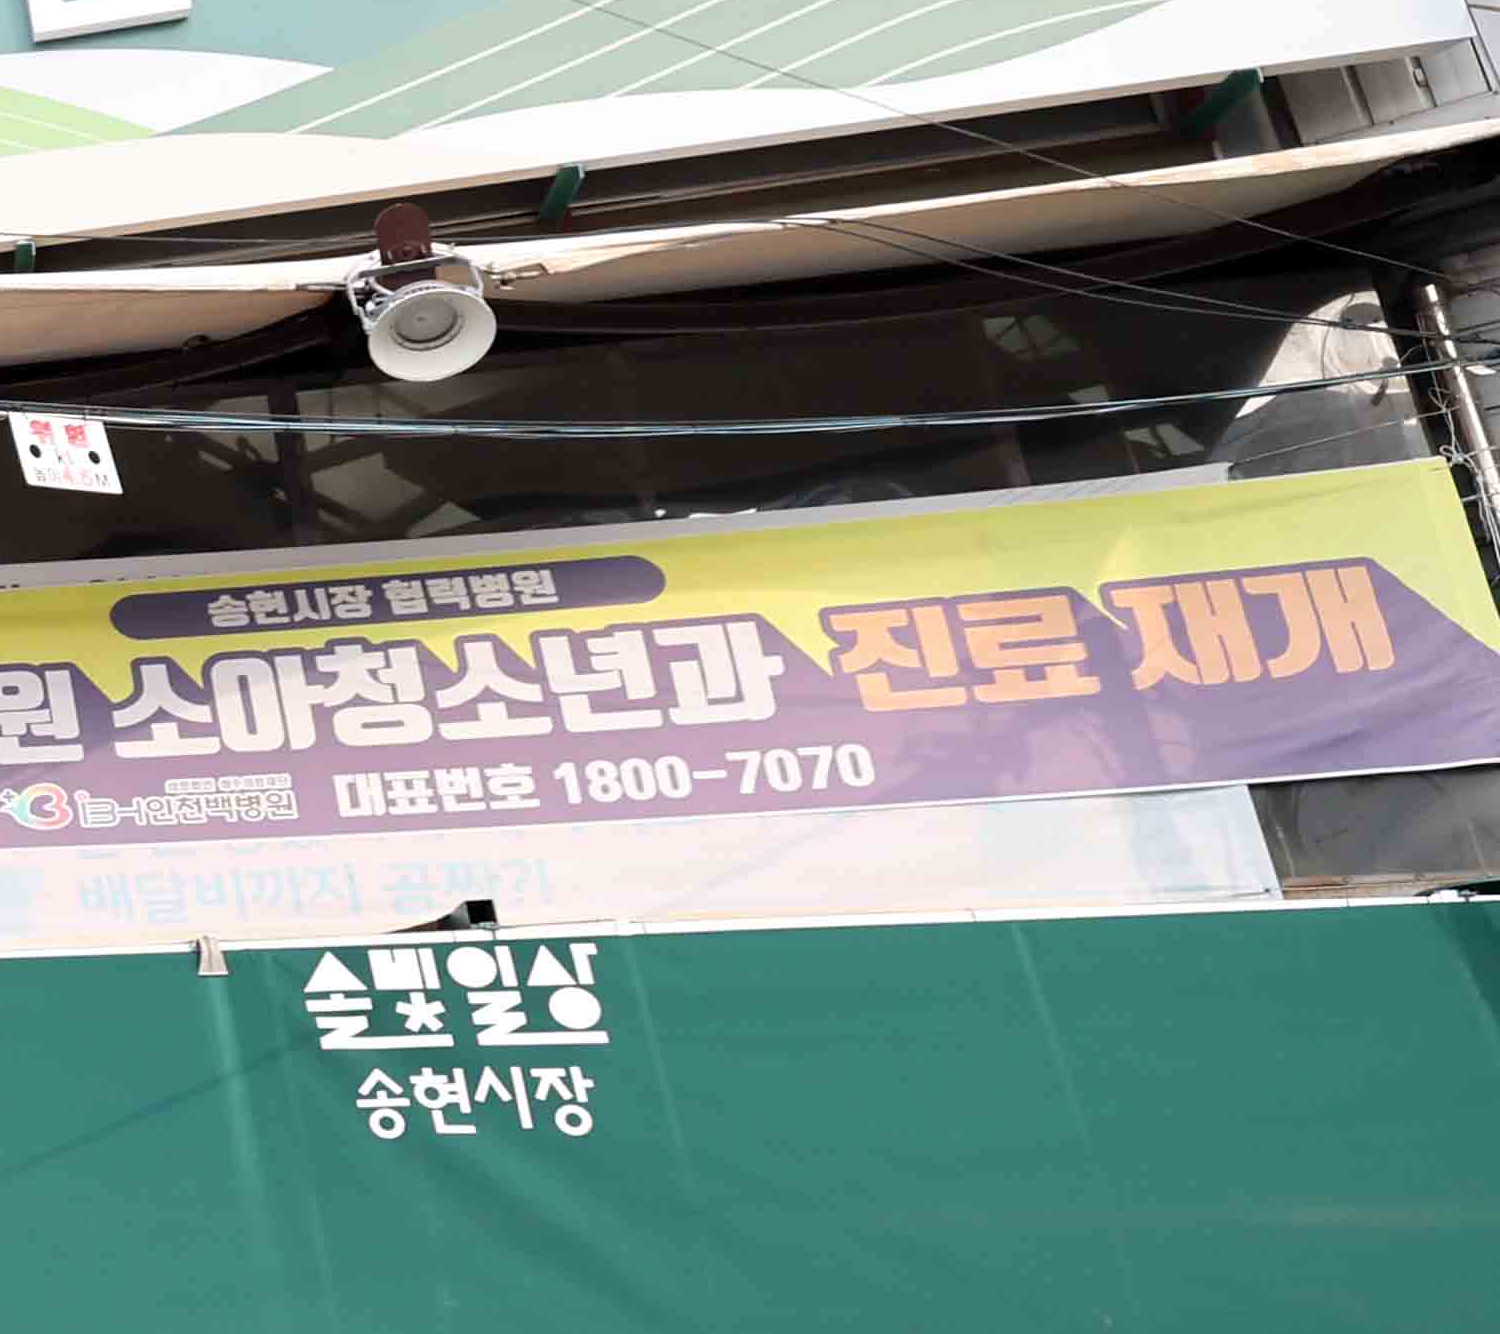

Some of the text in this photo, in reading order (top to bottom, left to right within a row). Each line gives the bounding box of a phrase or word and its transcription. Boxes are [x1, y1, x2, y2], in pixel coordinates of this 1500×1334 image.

[206, 577, 374, 628] 송현시장
[383, 566, 559, 616] 협력병원
[112, 619, 787, 761] 소아청소년과
[826, 591, 1103, 714] 진료
[1123, 563, 1396, 689] 재개
[145, 789, 300, 826] 인천백병원
[335, 743, 876, 820] 대표번호 1800-7070
[355, 1064, 595, 1139] 송현시장
